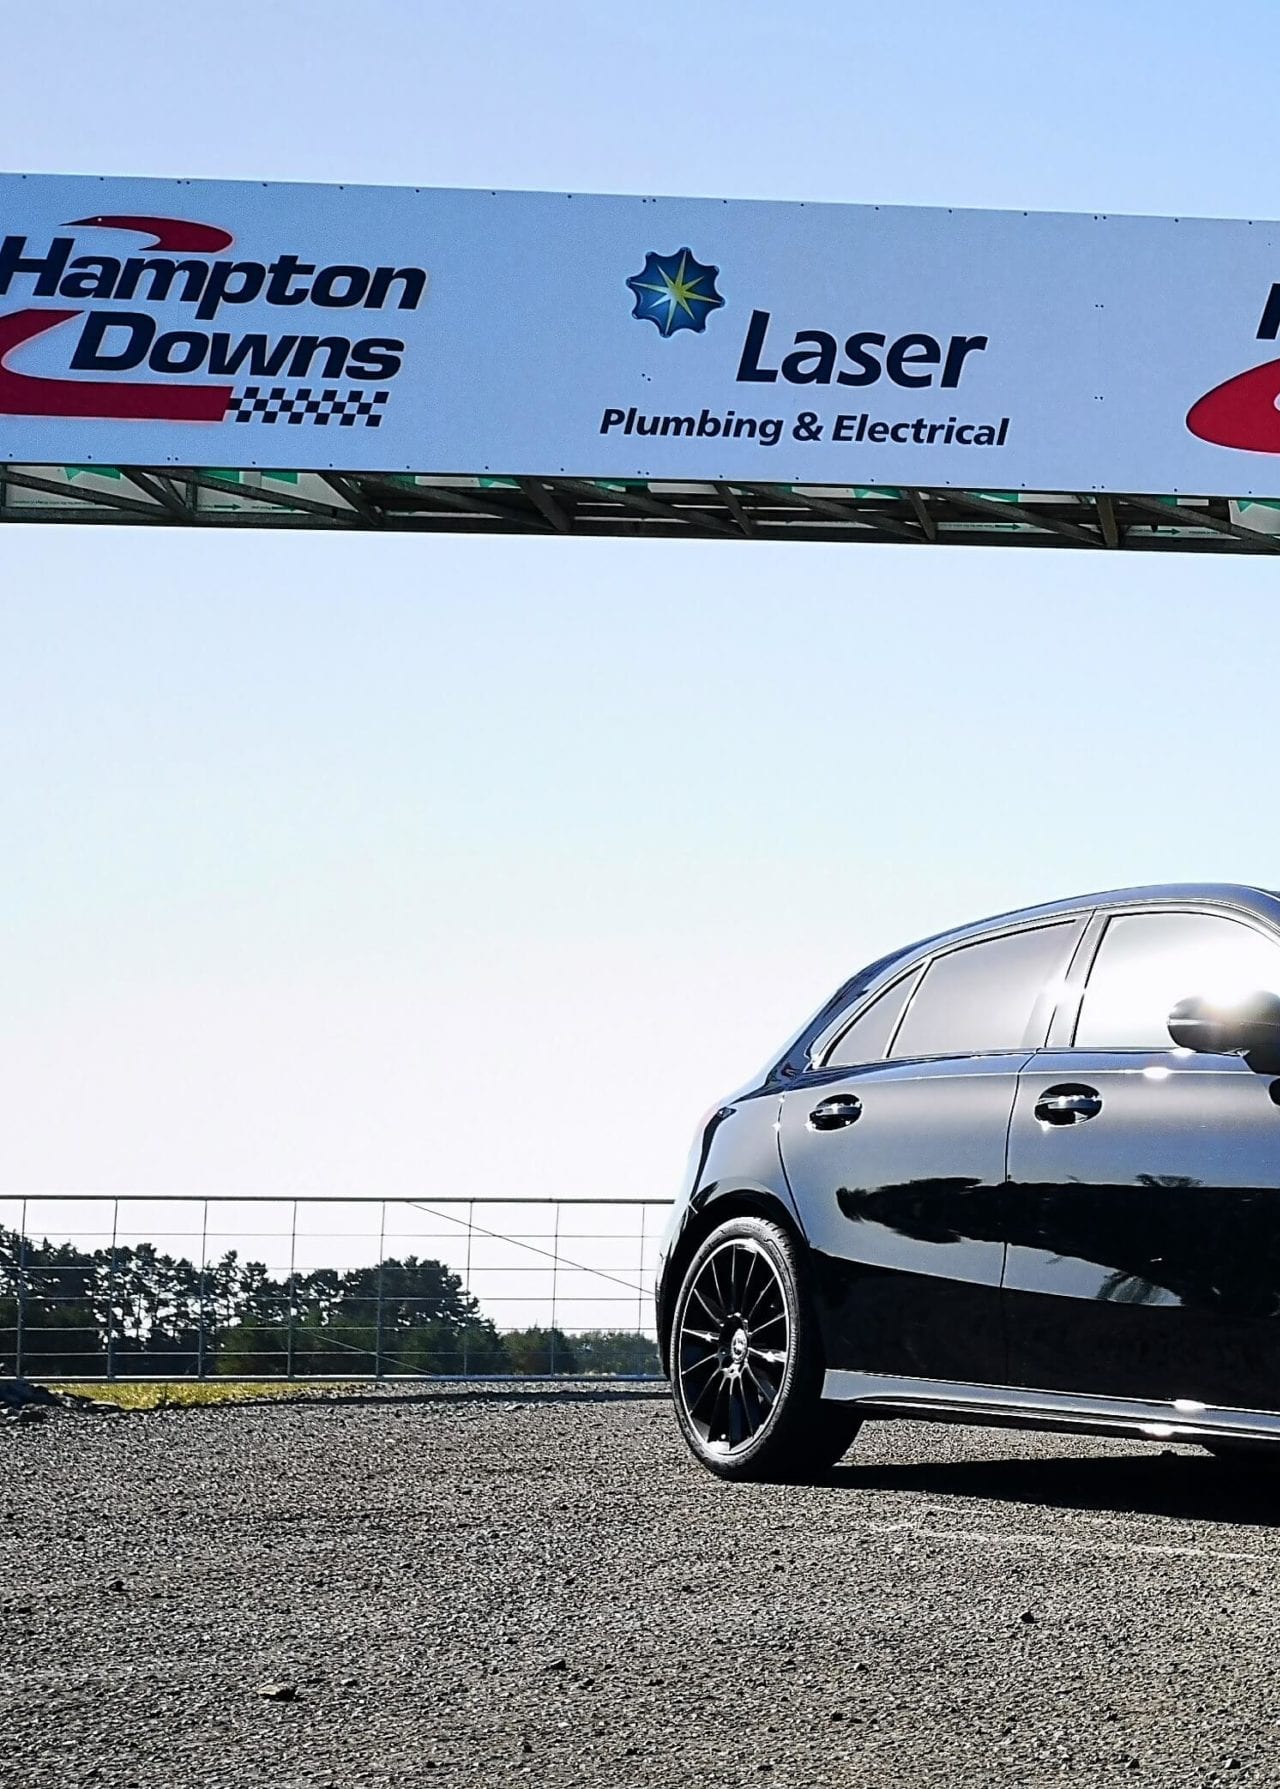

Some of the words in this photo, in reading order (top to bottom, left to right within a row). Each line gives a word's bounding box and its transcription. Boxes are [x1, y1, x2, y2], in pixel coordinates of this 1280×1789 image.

[0, 235, 427, 321] Hampton
[69, 310, 405, 381] Downs
[735, 309, 988, 389] Laser
[599, 407, 784, 447] Plumbing
[792, 411, 824, 442] &
[831, 413, 1010, 446] Electrical
